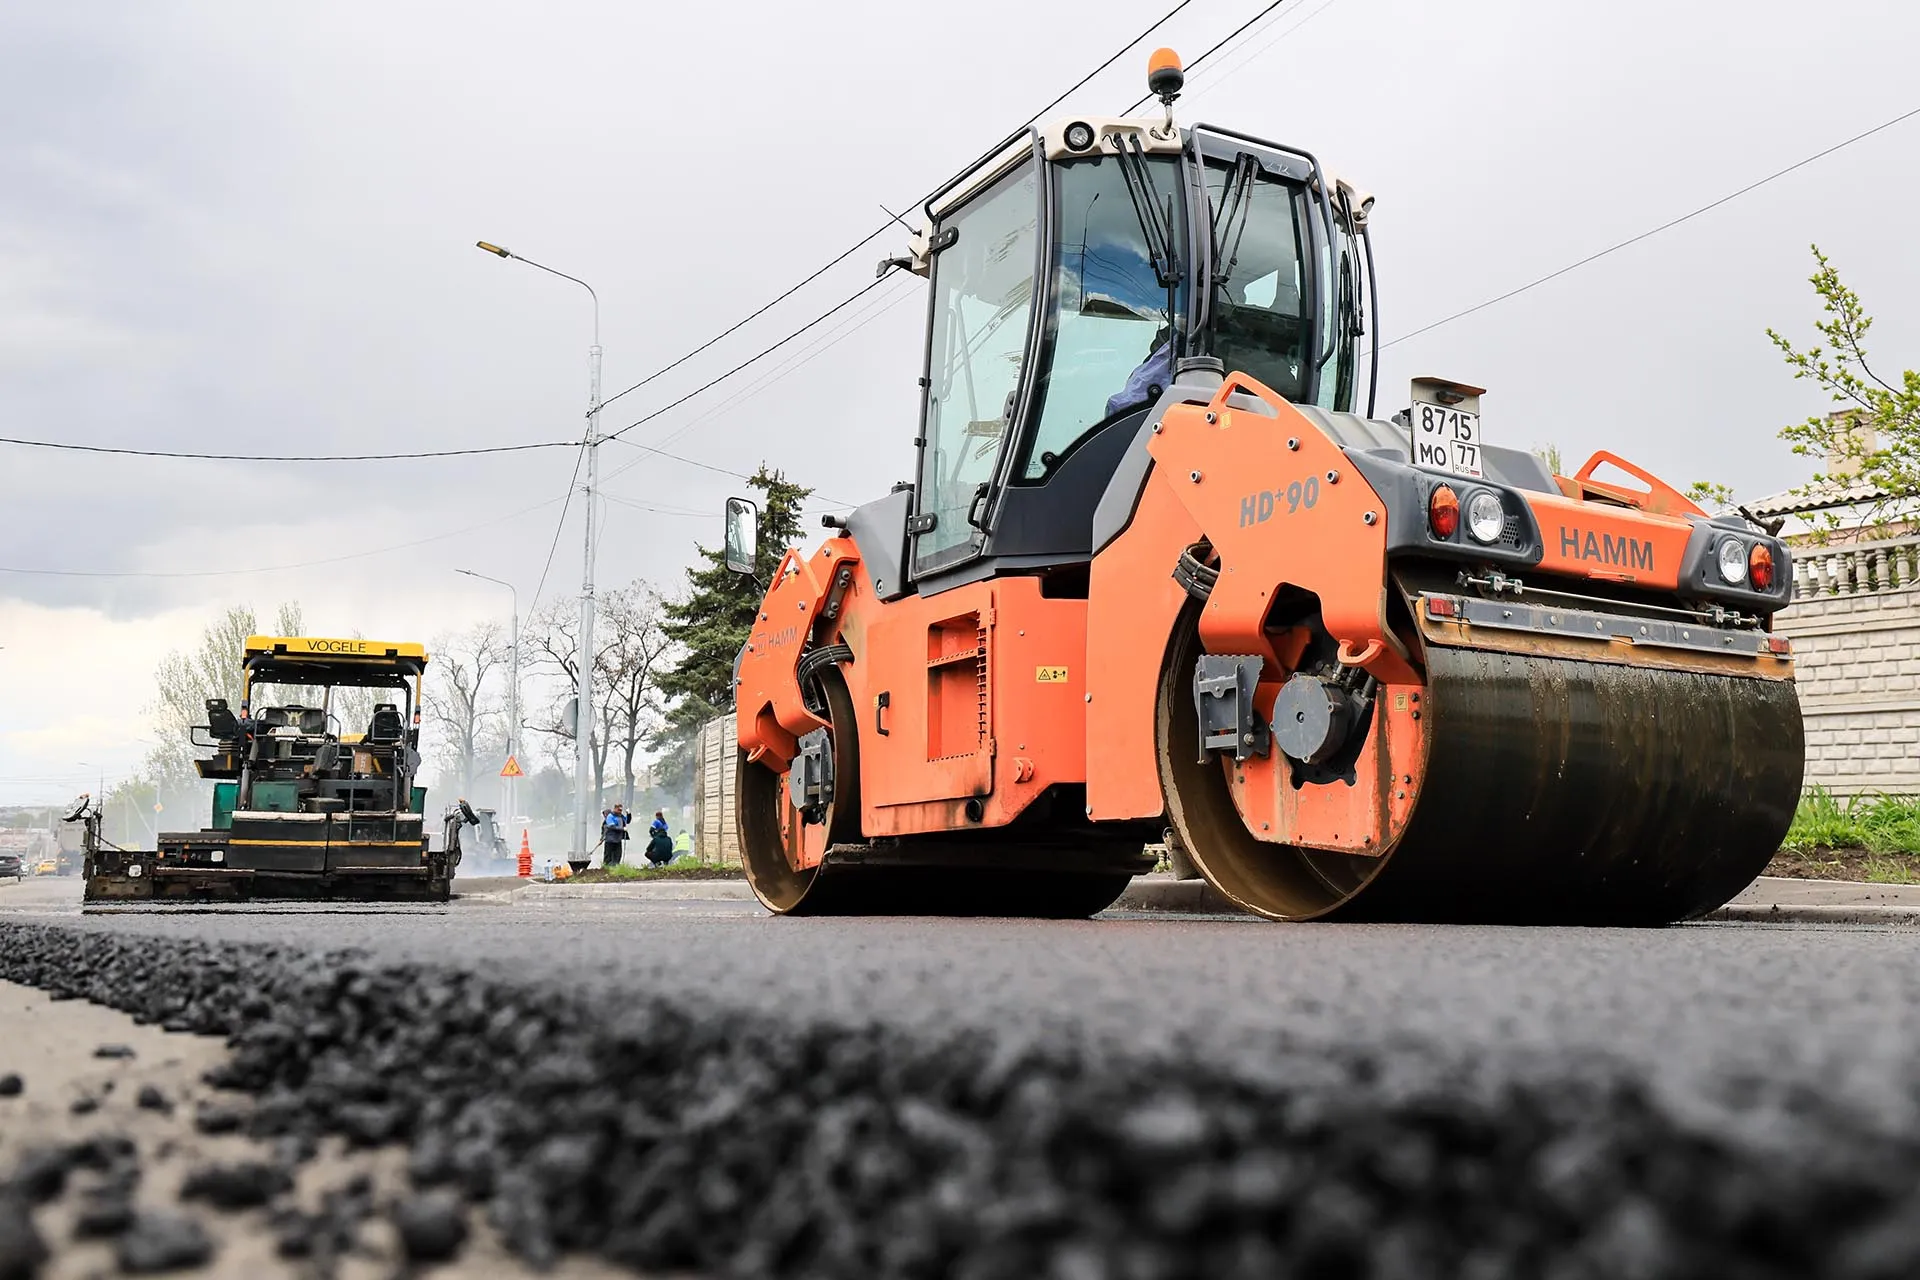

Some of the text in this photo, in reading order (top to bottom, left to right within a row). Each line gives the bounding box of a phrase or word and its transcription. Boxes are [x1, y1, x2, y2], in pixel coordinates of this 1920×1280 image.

[1422, 406, 1472, 441] 8715
[1420, 442, 1447, 466] MO
[1457, 444, 1476, 467] 77
[1455, 464, 1470, 474] RUS
[1560, 526, 1654, 571] HAMM
[768, 626, 798, 649] HAMM
